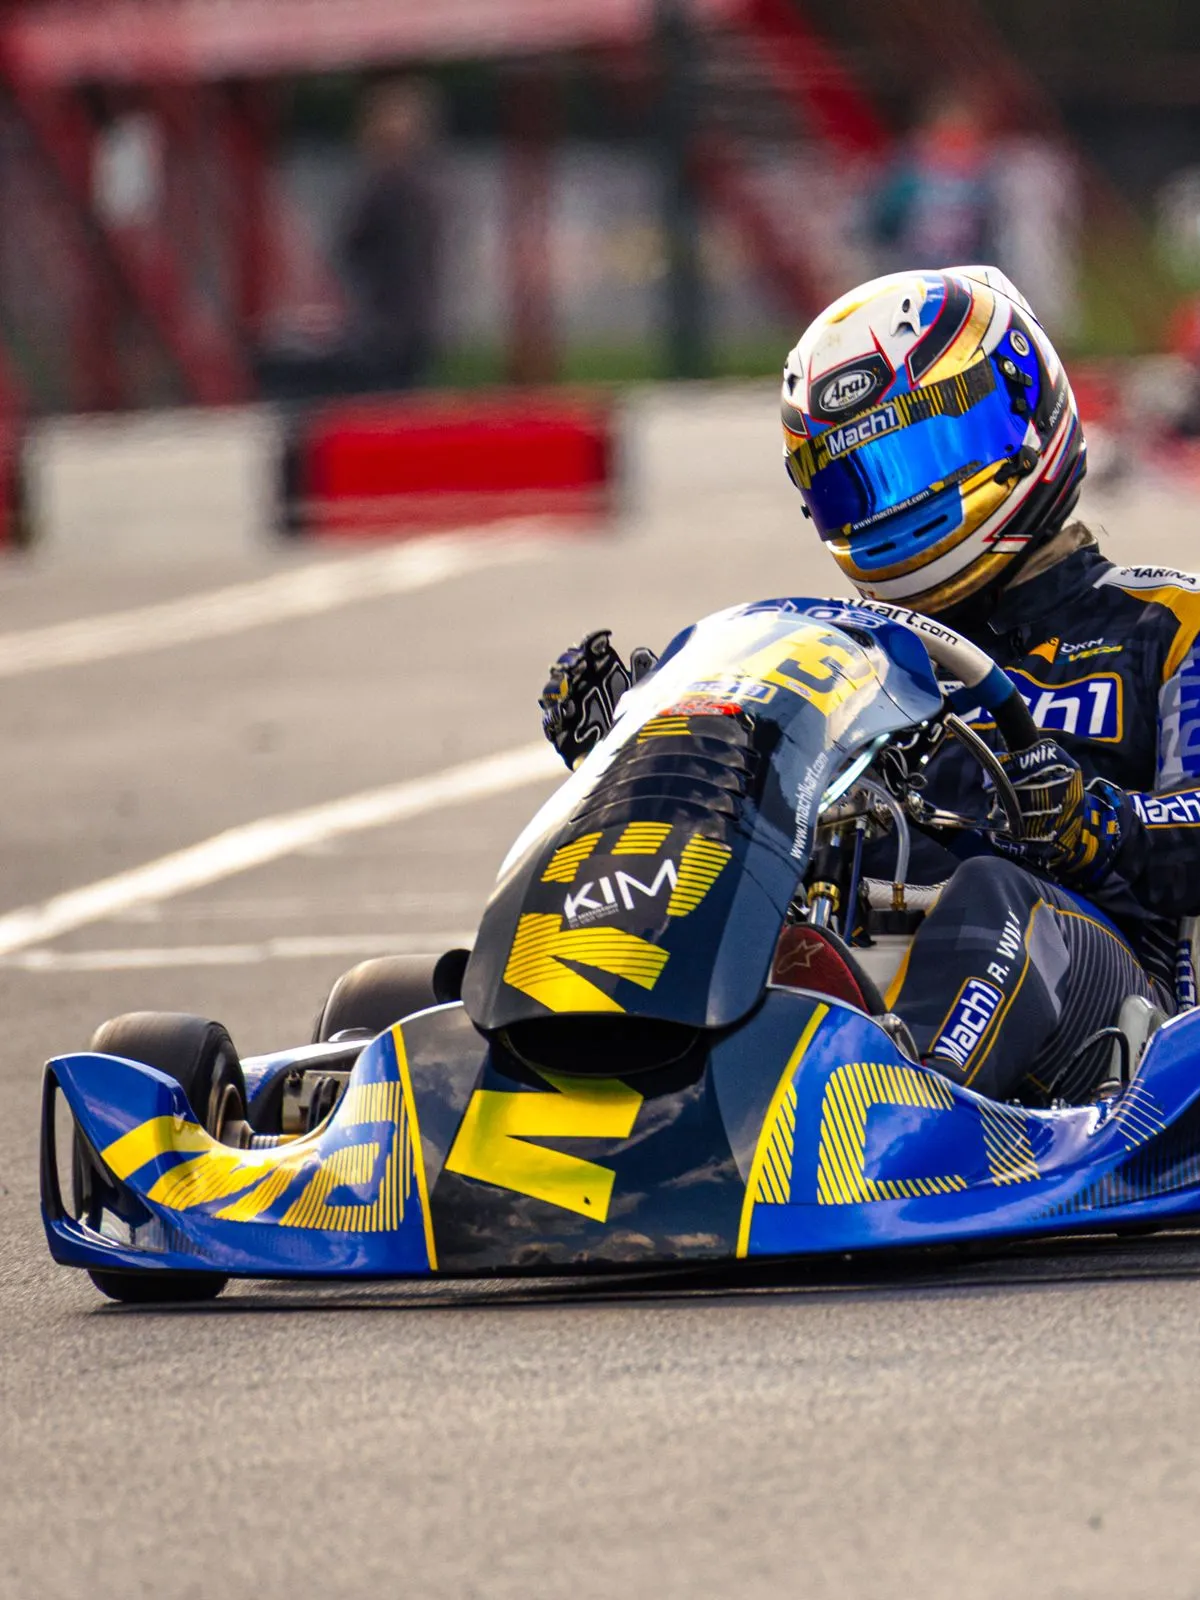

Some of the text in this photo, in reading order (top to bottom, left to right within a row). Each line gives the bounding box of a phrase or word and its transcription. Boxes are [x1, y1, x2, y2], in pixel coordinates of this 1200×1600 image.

[827, 378, 869, 401] Arai
[830, 406, 897, 456] Mach1
[564, 858, 679, 919] KIM
[935, 979, 1000, 1066] Mach1
